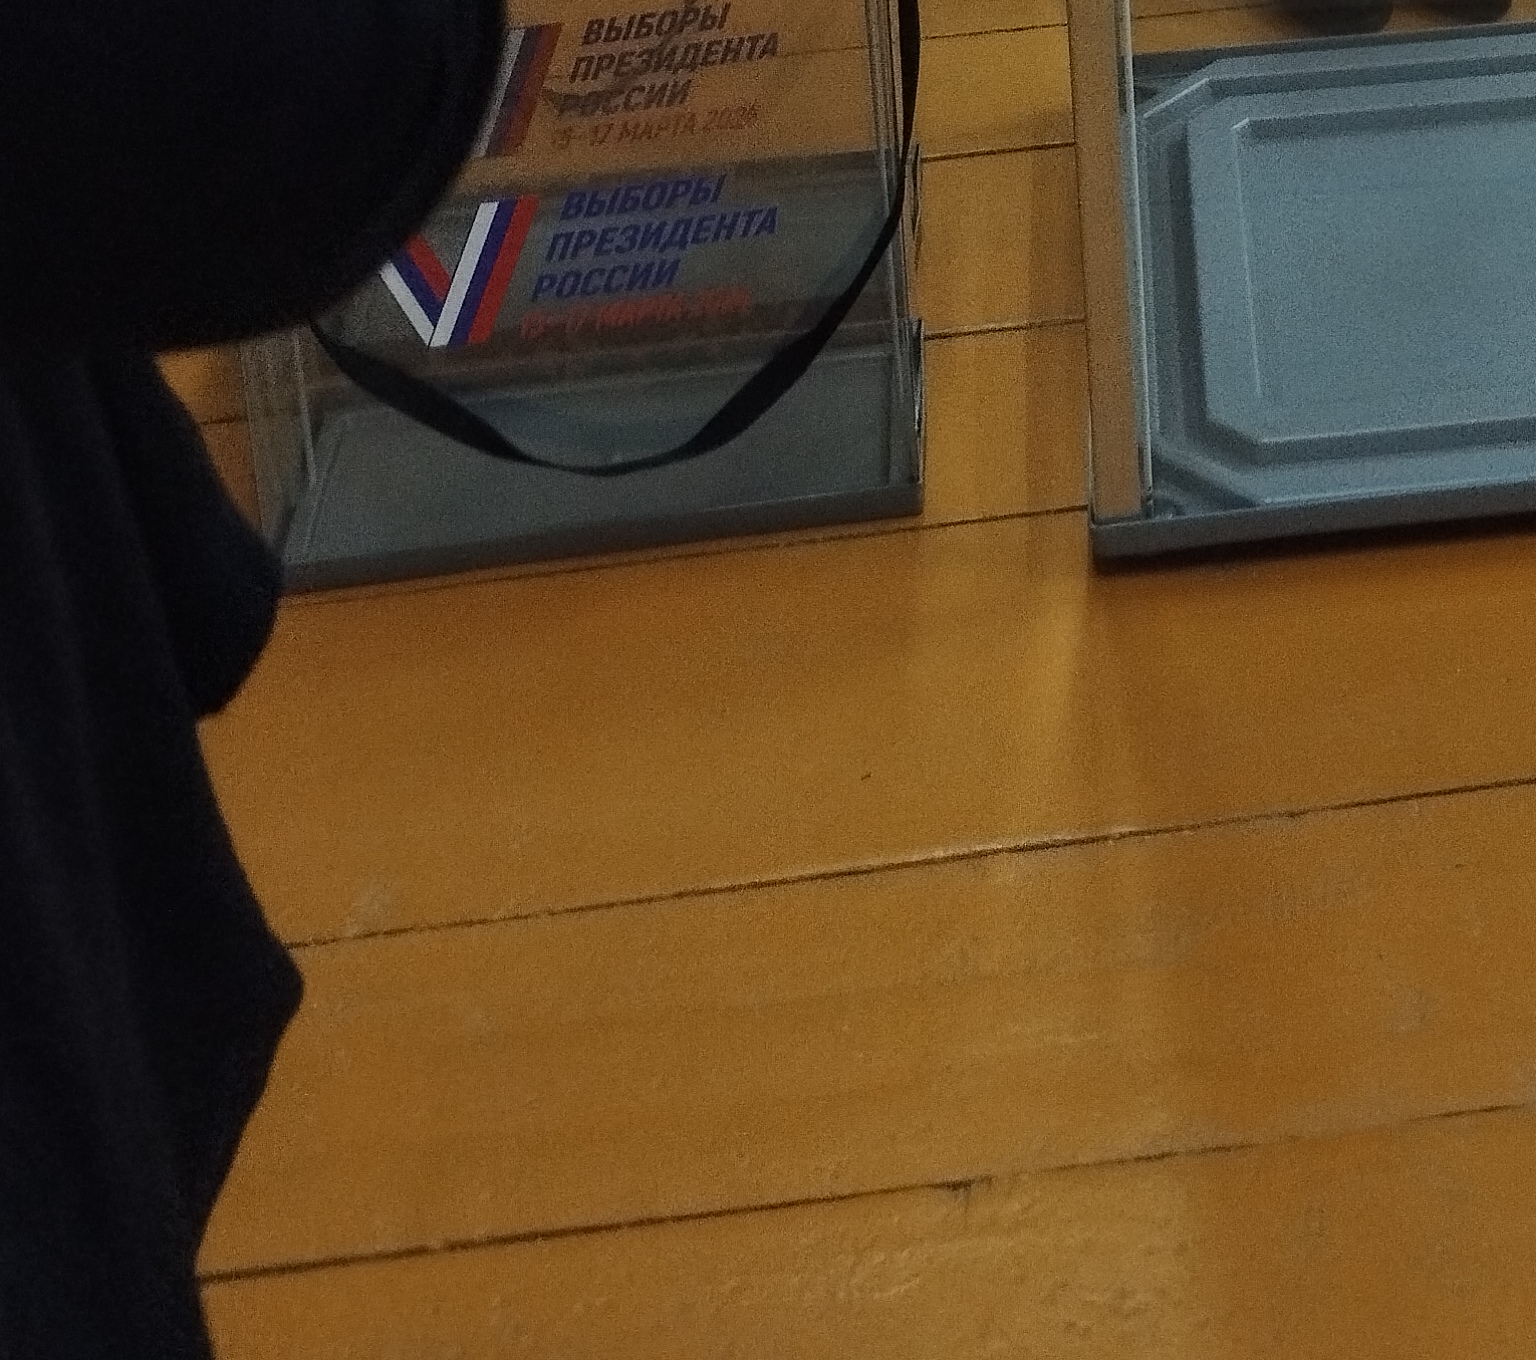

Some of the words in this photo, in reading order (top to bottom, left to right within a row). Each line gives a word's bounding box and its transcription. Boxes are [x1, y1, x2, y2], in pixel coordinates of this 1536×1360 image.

[582, 2, 731, 46] ВЫБОРЫ
[569, 32, 778, 83] ПРЕЗИДЕНТА
[560, 173, 728, 221] ВЫБОРЫ
[546, 206, 778, 263] ПРЕЗИДЕНТА
[531, 258, 681, 303] РОССИИ
